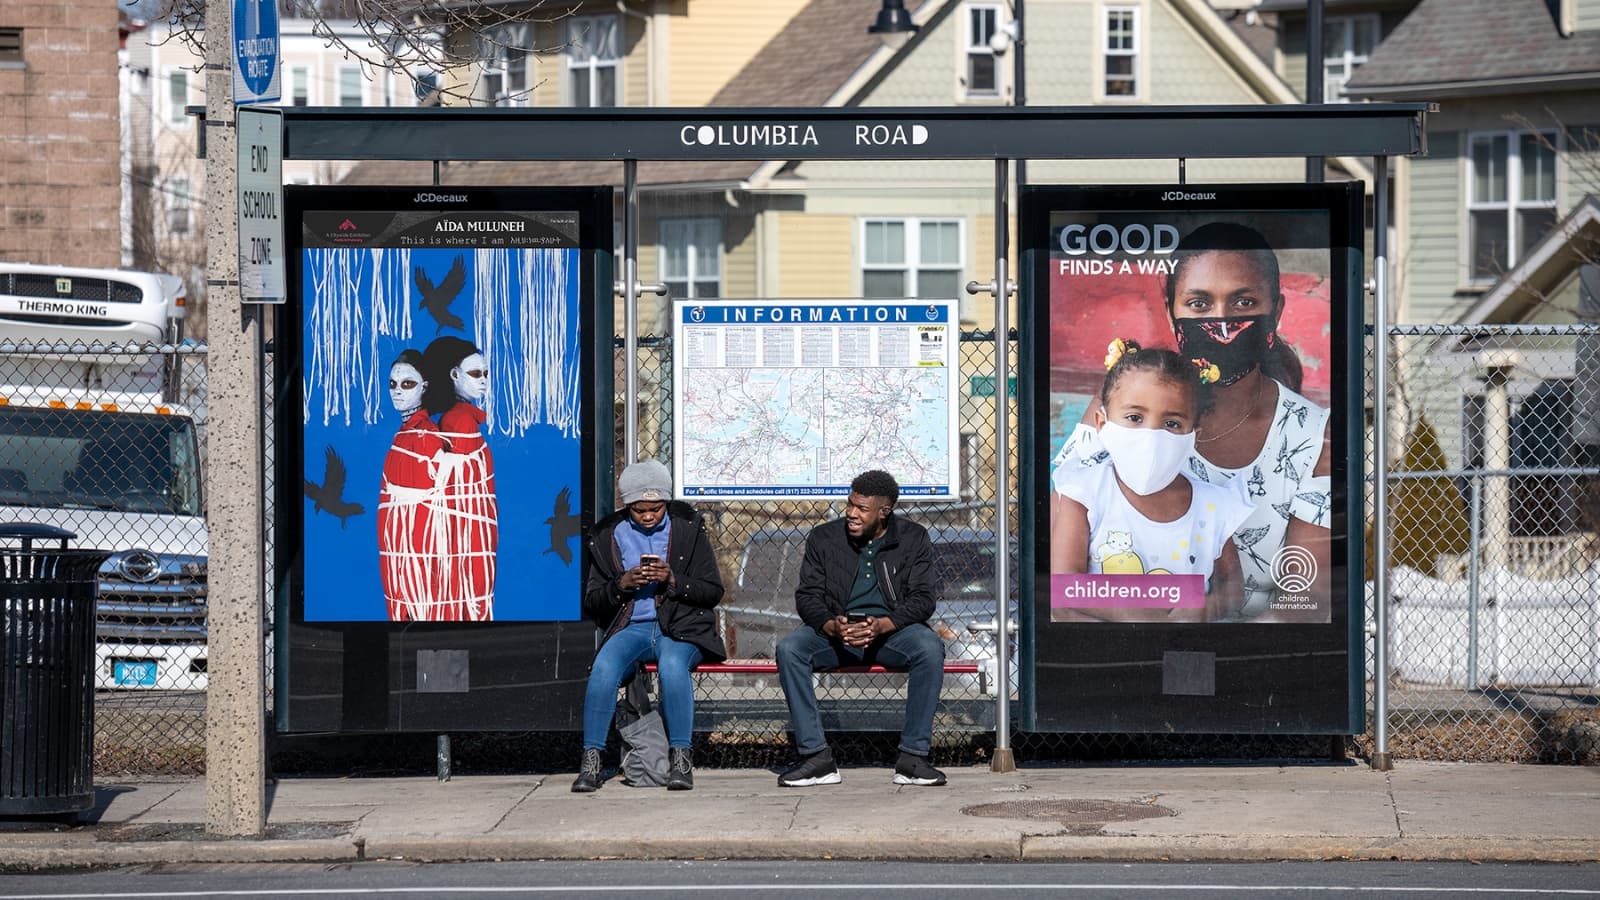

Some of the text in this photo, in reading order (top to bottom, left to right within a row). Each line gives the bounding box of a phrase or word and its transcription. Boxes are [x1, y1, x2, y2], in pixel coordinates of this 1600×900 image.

[238, 37, 276, 58] EVACUATION
[247, 59, 269, 79] ROUTE
[680, 125, 929, 146] COLUMBIA ROAD
[251, 145, 268, 173] END
[413, 192, 469, 203] JCDecaux
[1161, 191, 1217, 201] JCDecaux
[243, 191, 277, 220] SCHOOL
[435, 219, 525, 232] AÏDA MULUNEH
[400, 235, 504, 245] This is where I am
[1060, 223, 1180, 256] GOOD
[250, 237, 272, 265] ZONE
[1060, 259, 1180, 275] FINDS A WAY
[18, 300, 108, 316] THERMO KING
[723, 307, 909, 322] INFORMATION
[685, 487, 695, 495] For
[718, 487, 733, 495] times
[734, 487, 745, 495] and
[746, 487, 773, 495] schedules
[774, 487, 785, 495] call
[1064, 580, 1181, 603] children.org
[1278, 594, 1310, 602] children
[1270, 602, 1318, 610] international
